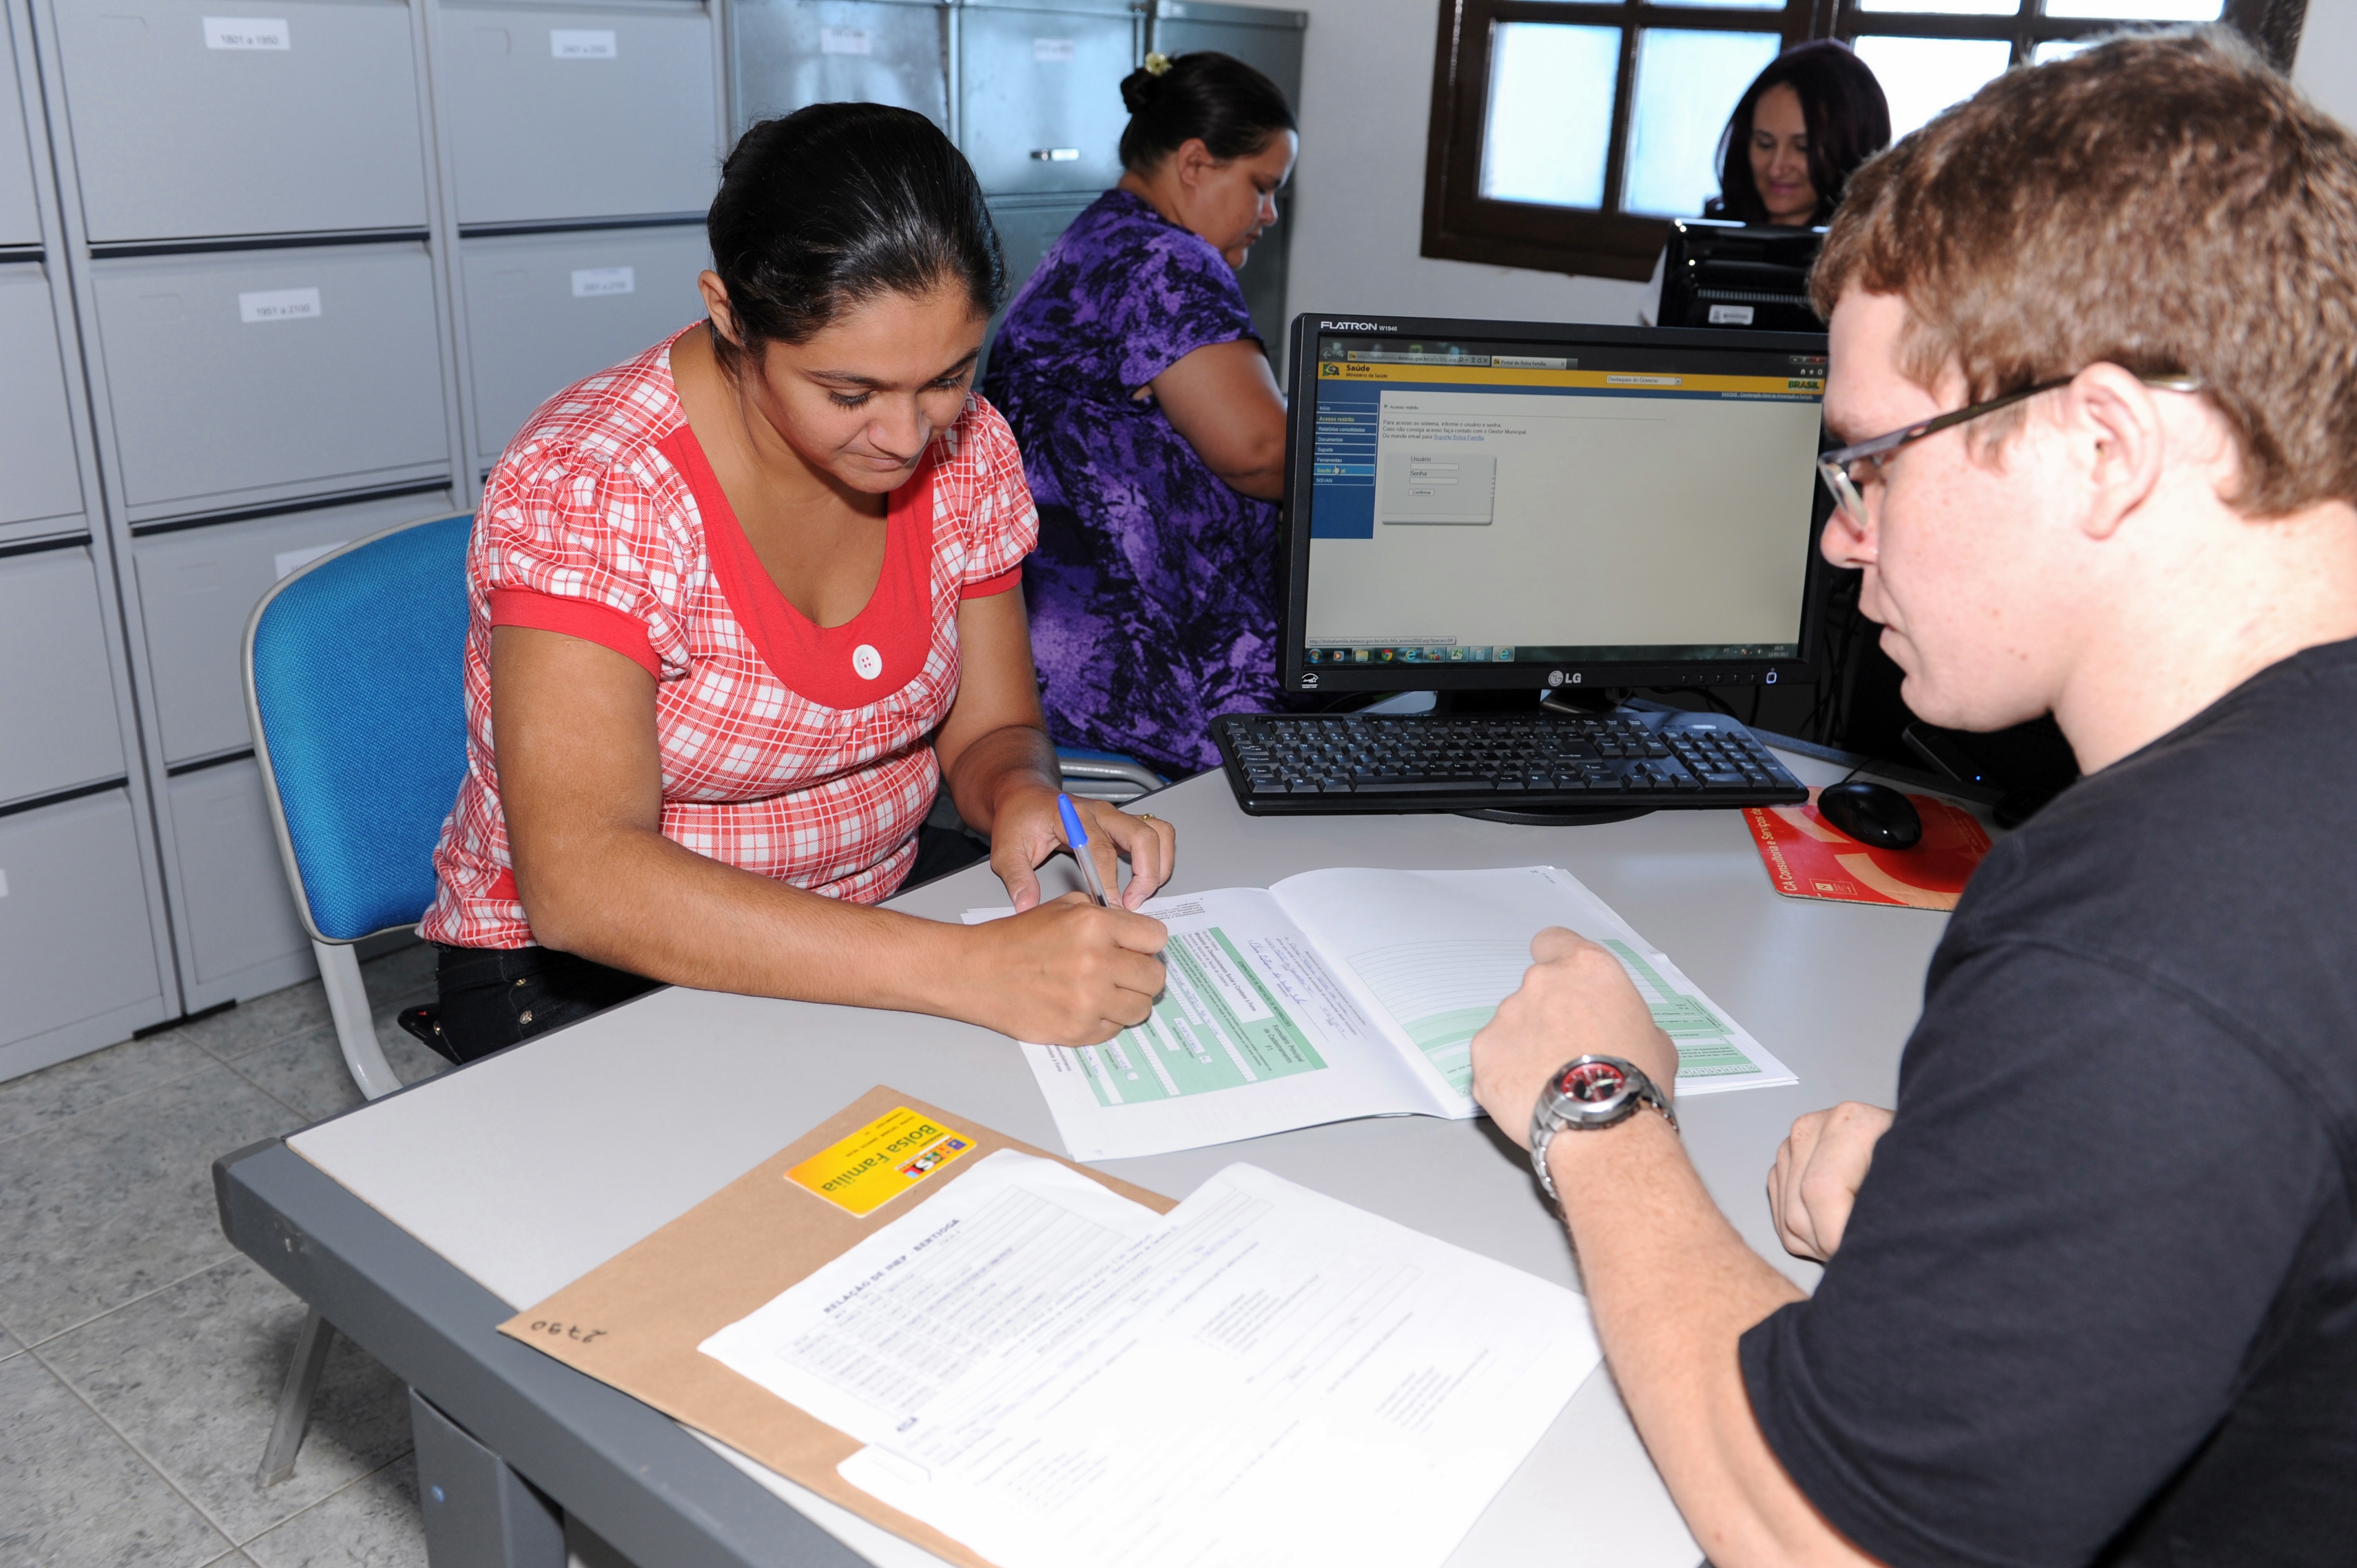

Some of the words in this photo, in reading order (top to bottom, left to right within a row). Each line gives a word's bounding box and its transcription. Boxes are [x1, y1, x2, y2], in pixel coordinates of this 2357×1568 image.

[1321, 321, 1377, 331] FLATRON
[1788, 380, 1820, 389] BRASIL
[1565, 673, 1581, 683] LG
[1756, 816, 1774, 840] Serviços
[1768, 845, 1793, 880] Consultoria
[1782, 881, 1798, 891] CA
[1180, 934, 1195, 949] Departamento
[1201, 931, 1213, 941] Governo
[1209, 941, 1220, 951] Federal
[1186, 933, 1200, 946] Secretaria
[1196, 946, 1207, 957] Nacional
[1207, 961, 1217, 969] Renda
[1217, 973, 1230, 987] Cidadania
[1193, 932, 1207, 945] Ministério
[1207, 949, 1228, 973] Desenvolvimento
[1225, 973, 1235, 982] Social
[1234, 986, 1248, 999] Combate
[1247, 1002, 1257, 1011] Fome
[1236, 961, 1255, 981] COMPROVANTE
[1255, 985, 1272, 1002] PRESTAÇÃO
[1272, 1006, 1291, 1027] INFORMAÇÕES
[1267, 1034, 1294, 1063] Cadastramento
[1270, 1024, 1291, 1045] Formulário
[1286, 1045, 1305, 1062] Principal
[1043, 1045, 1055, 1059] ombate
[1054, 1061, 1064, 1072] Fome
[886, 1124, 938, 1154] Bolsa
[821, 1153, 891, 1193] Família
[824, 1280, 871, 1314] RELAÇÃO
[870, 1270, 884, 1281] DE
[913, 1217, 960, 1252] BERTIOGA
